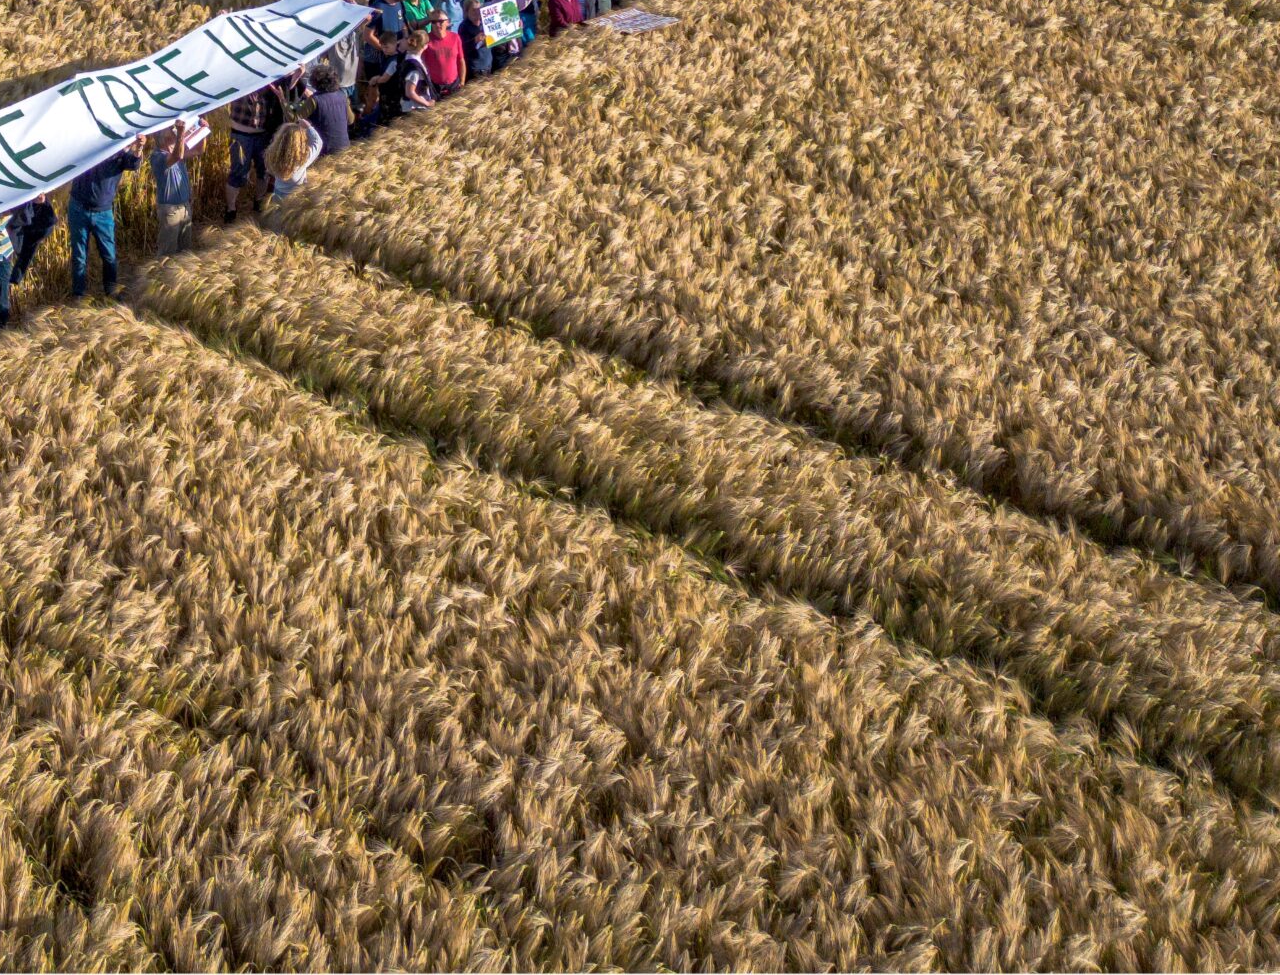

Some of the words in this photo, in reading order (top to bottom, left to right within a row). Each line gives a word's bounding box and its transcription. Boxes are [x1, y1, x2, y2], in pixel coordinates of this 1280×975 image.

[482, 5, 498, 18] SAVE
[484, 15, 496, 26] ONE
[487, 21, 501, 33] TREE
[58, 49, 240, 140] TREE
[203, 9, 351, 78] HILL
